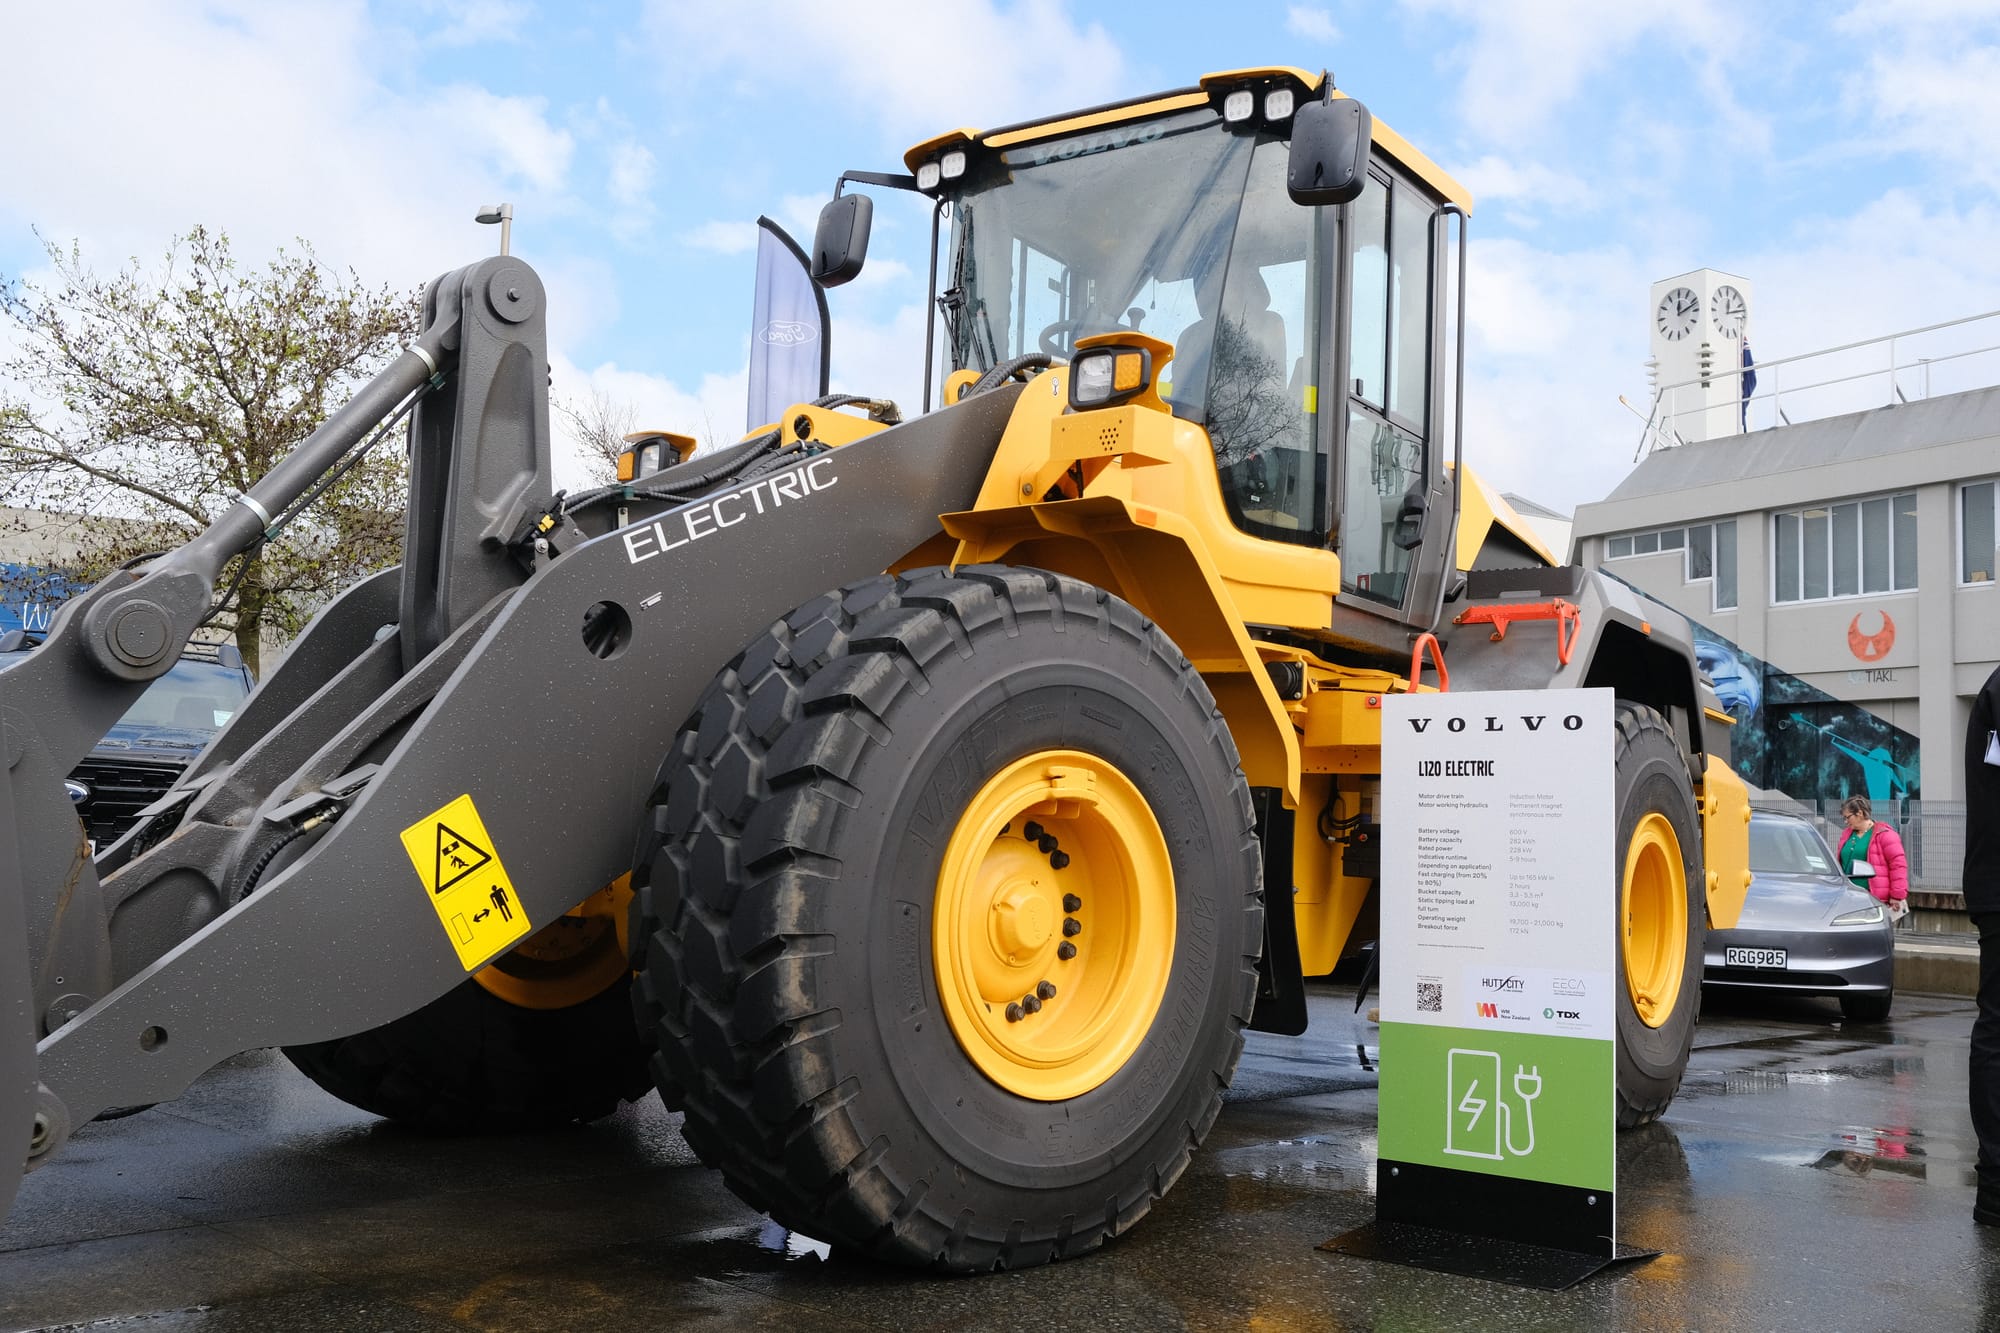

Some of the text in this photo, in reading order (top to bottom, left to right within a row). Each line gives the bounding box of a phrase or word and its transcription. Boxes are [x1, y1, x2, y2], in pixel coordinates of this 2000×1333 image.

[1030, 124, 1166, 166] VOLVO
[622, 457, 839, 564] ELECTRIC
[1408, 715, 1583, 732] VOLVO
[1418, 760, 1494, 776] L120 ELECTRIC
[1727, 949, 1785, 966] RGG905
[1482, 978, 1525, 990] HUTT CITY
[1552, 978, 1586, 990] EECA
[1556, 1010, 1581, 1020] TDX
